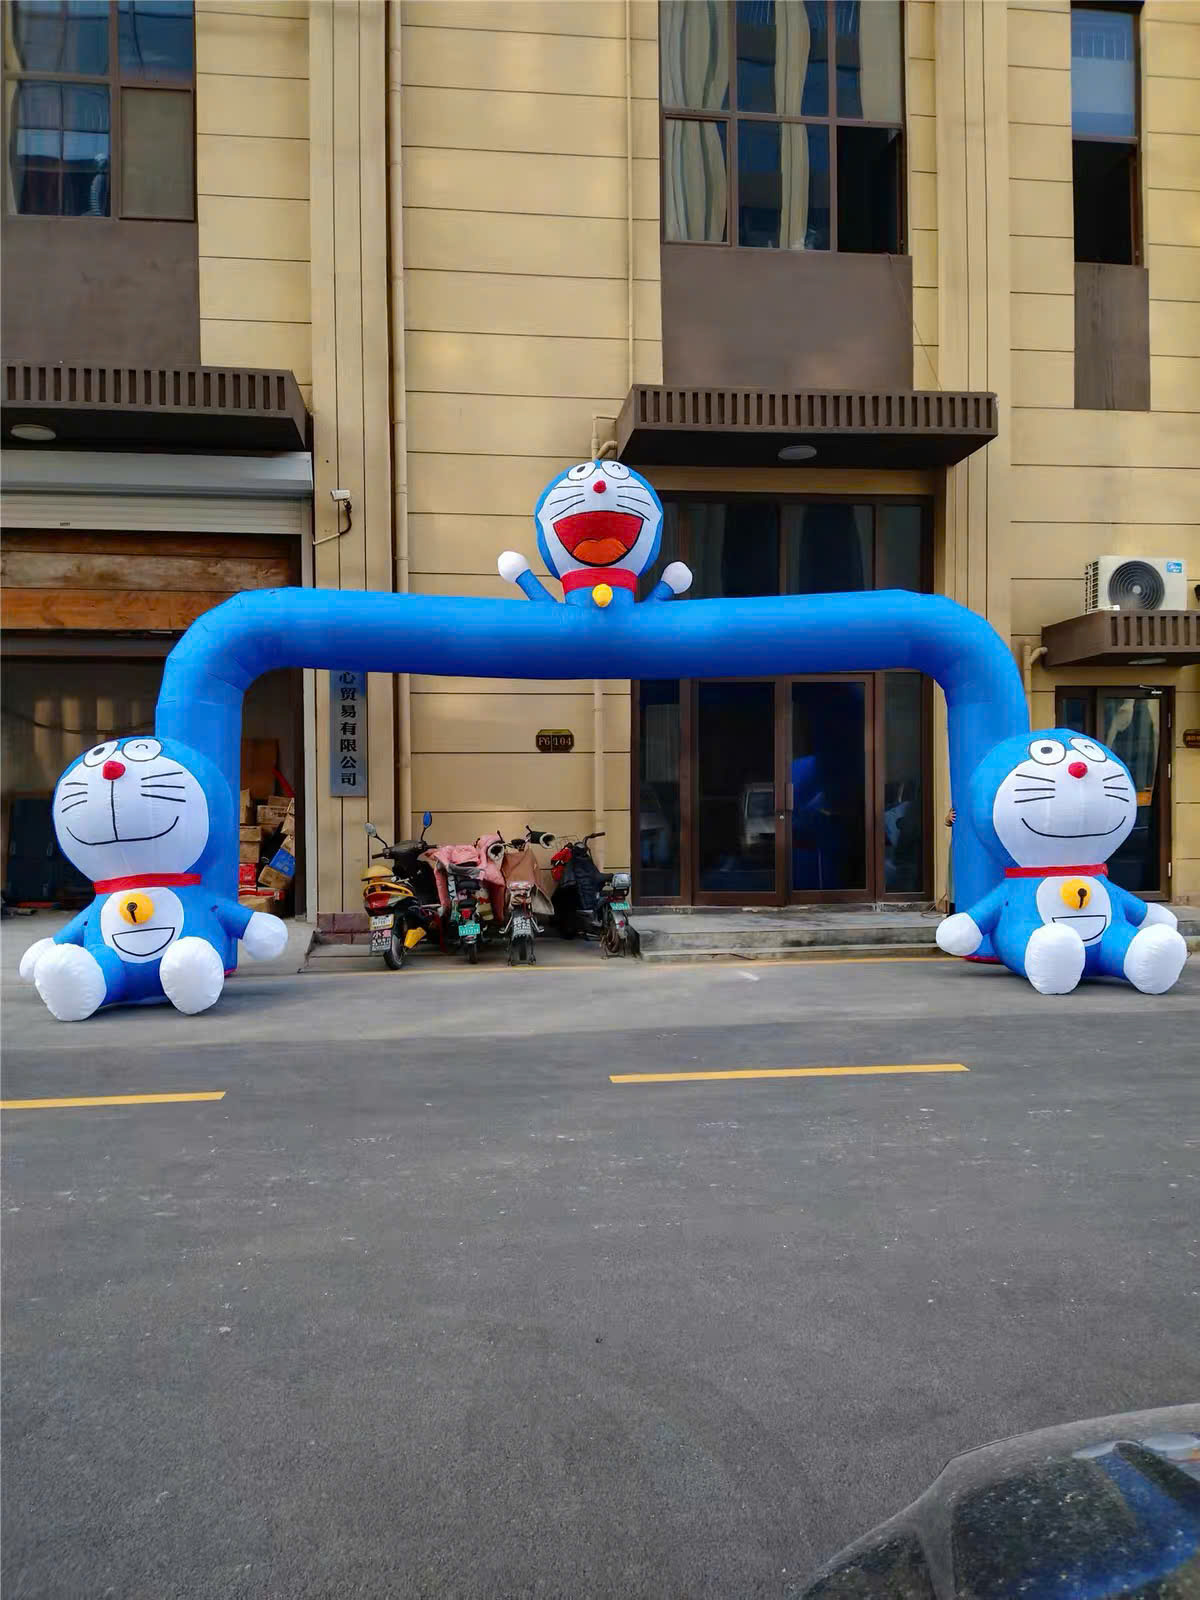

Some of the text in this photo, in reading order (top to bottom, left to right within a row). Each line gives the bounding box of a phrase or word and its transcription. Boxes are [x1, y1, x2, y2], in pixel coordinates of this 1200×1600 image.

[339, 671, 358, 787] 心贸易有限公司
